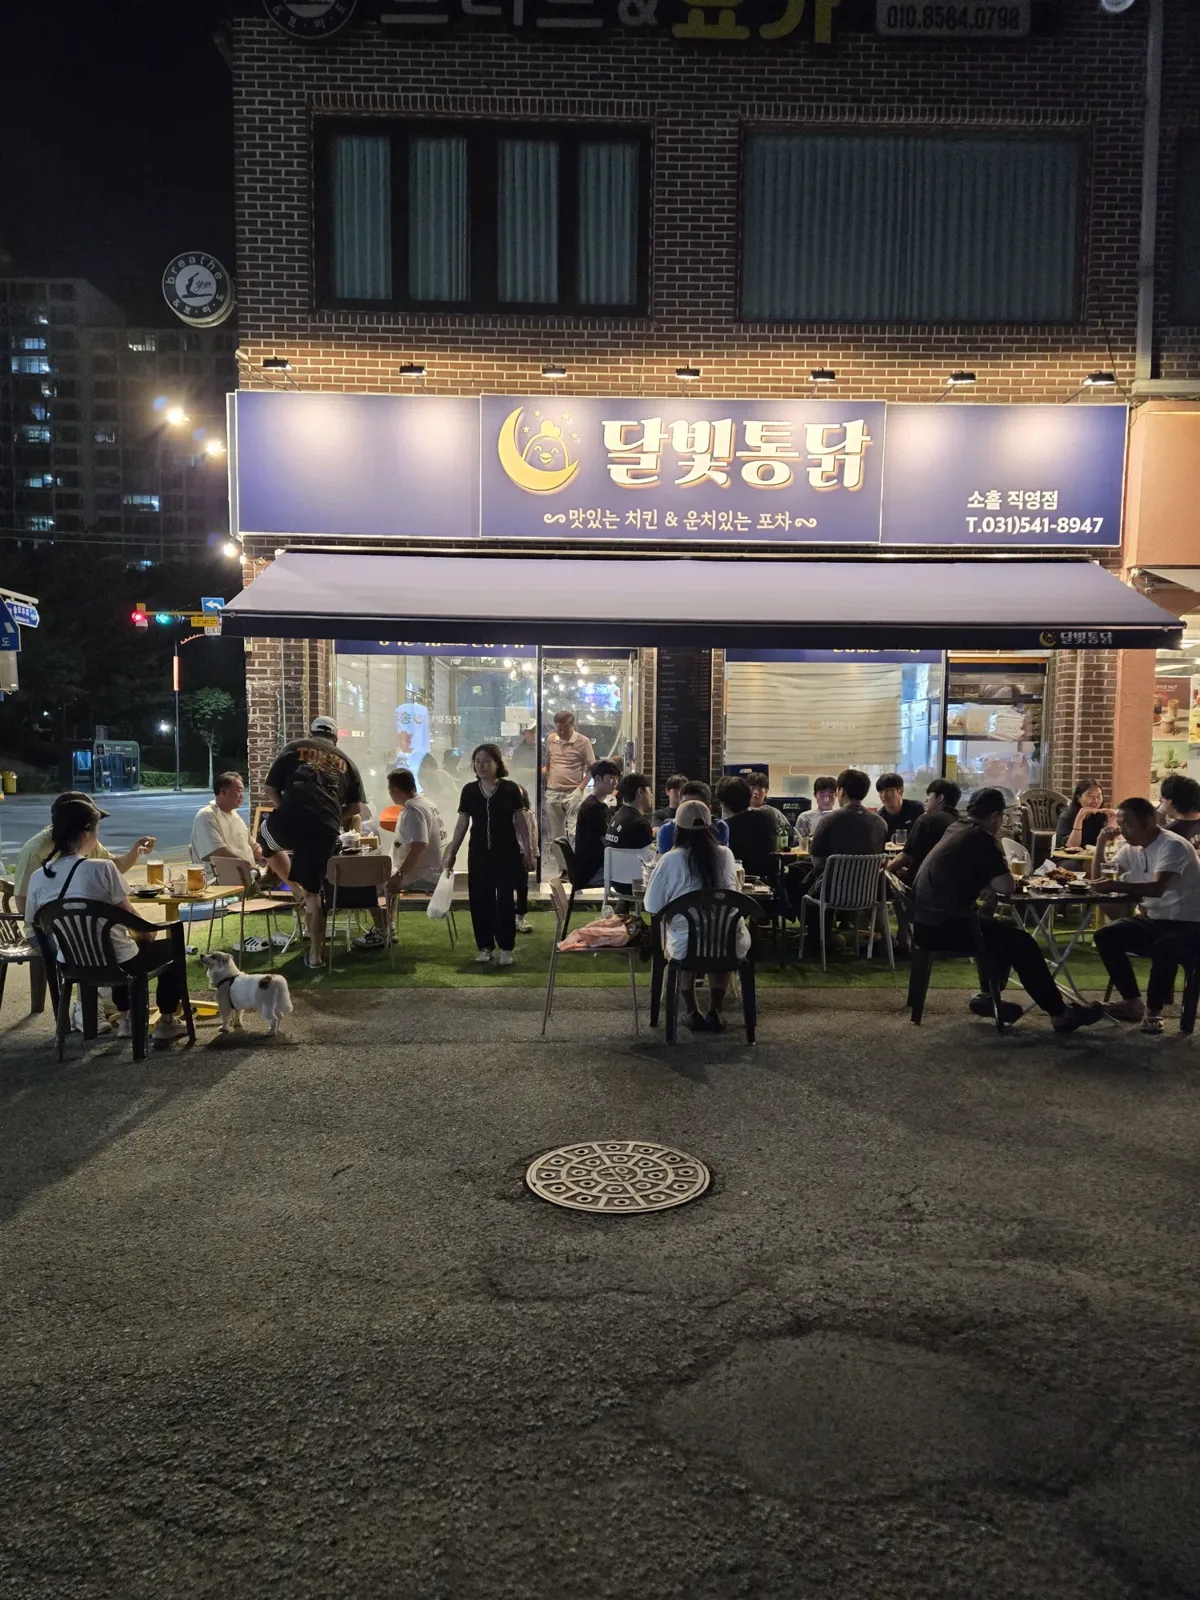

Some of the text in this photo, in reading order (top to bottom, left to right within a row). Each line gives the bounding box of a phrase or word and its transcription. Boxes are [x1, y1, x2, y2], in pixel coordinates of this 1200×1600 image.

[165, 255, 223, 284] breathe
[601, 416, 872, 490] 달빛통닭
[1007, 490, 1058, 510] 직영점
[568, 508, 792, 531] 맛있는 치킨 & 운치있는 포차
[966, 516, 1104, 534] T.031)541-8947
[1060, 631, 1114, 645] 달빛통닭
